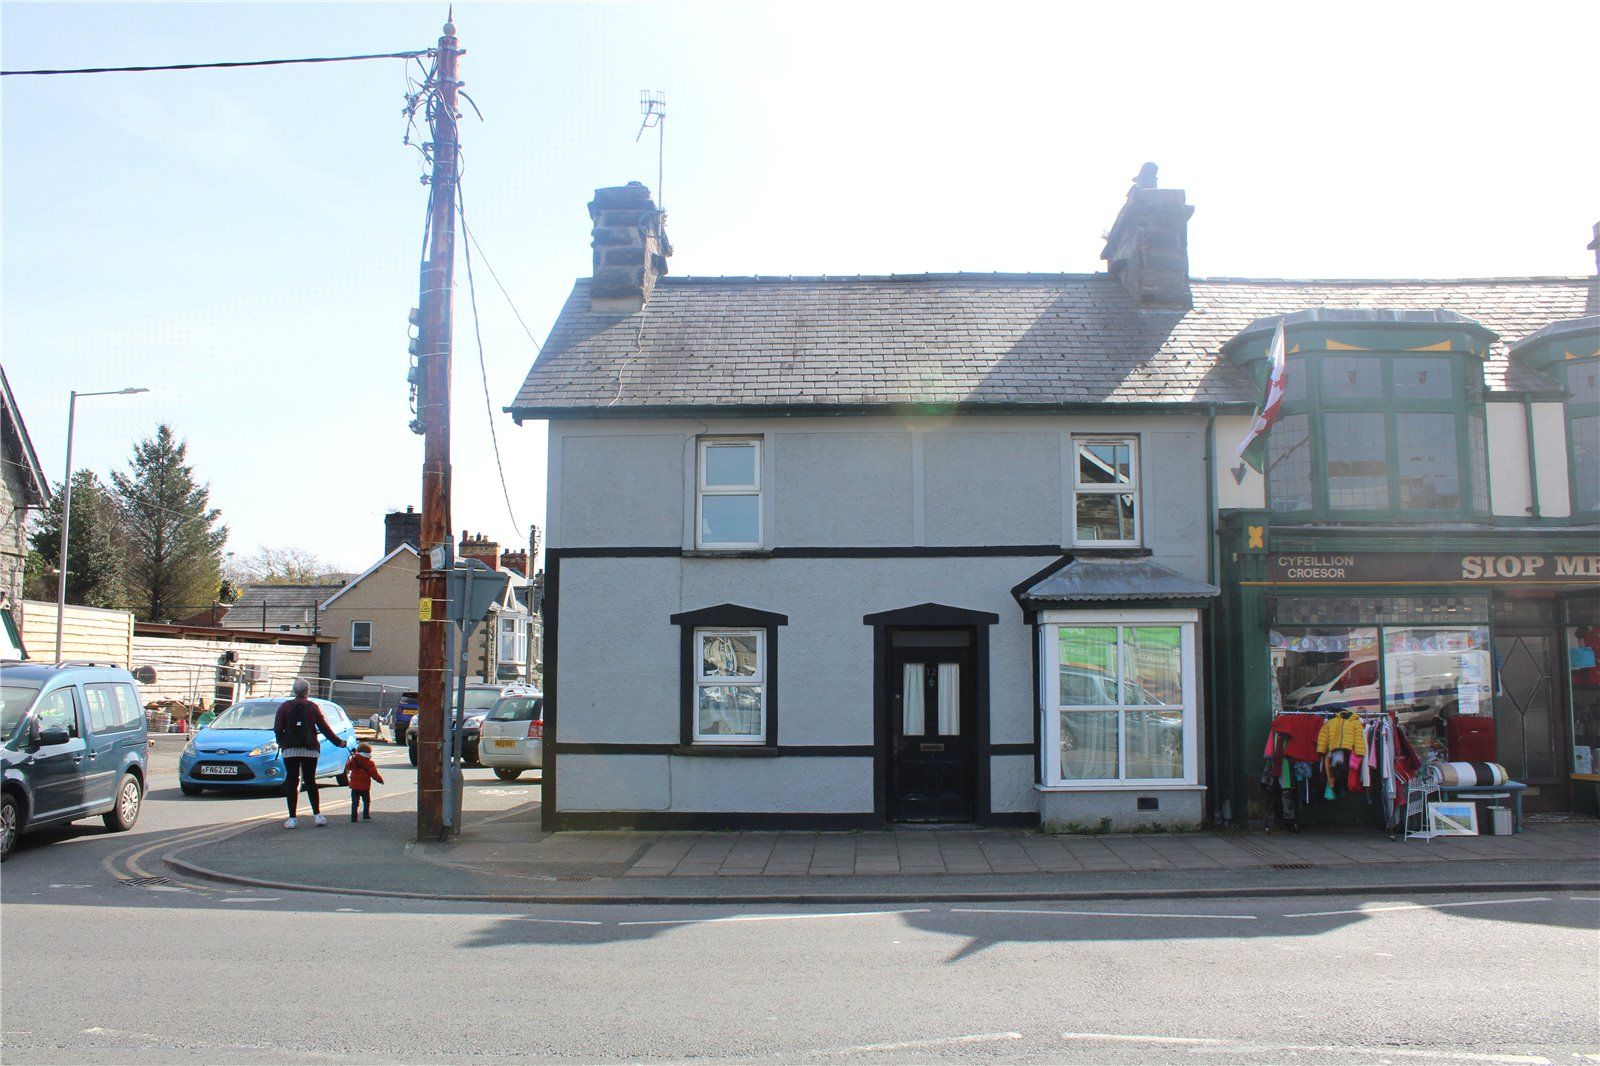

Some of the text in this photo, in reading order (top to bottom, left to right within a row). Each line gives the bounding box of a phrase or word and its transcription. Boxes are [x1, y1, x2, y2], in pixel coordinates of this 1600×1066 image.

[1279, 556, 1354, 566] CYFEILLION
[1461, 555, 1544, 578] SIOP
[1287, 568, 1345, 578] CROESOR
